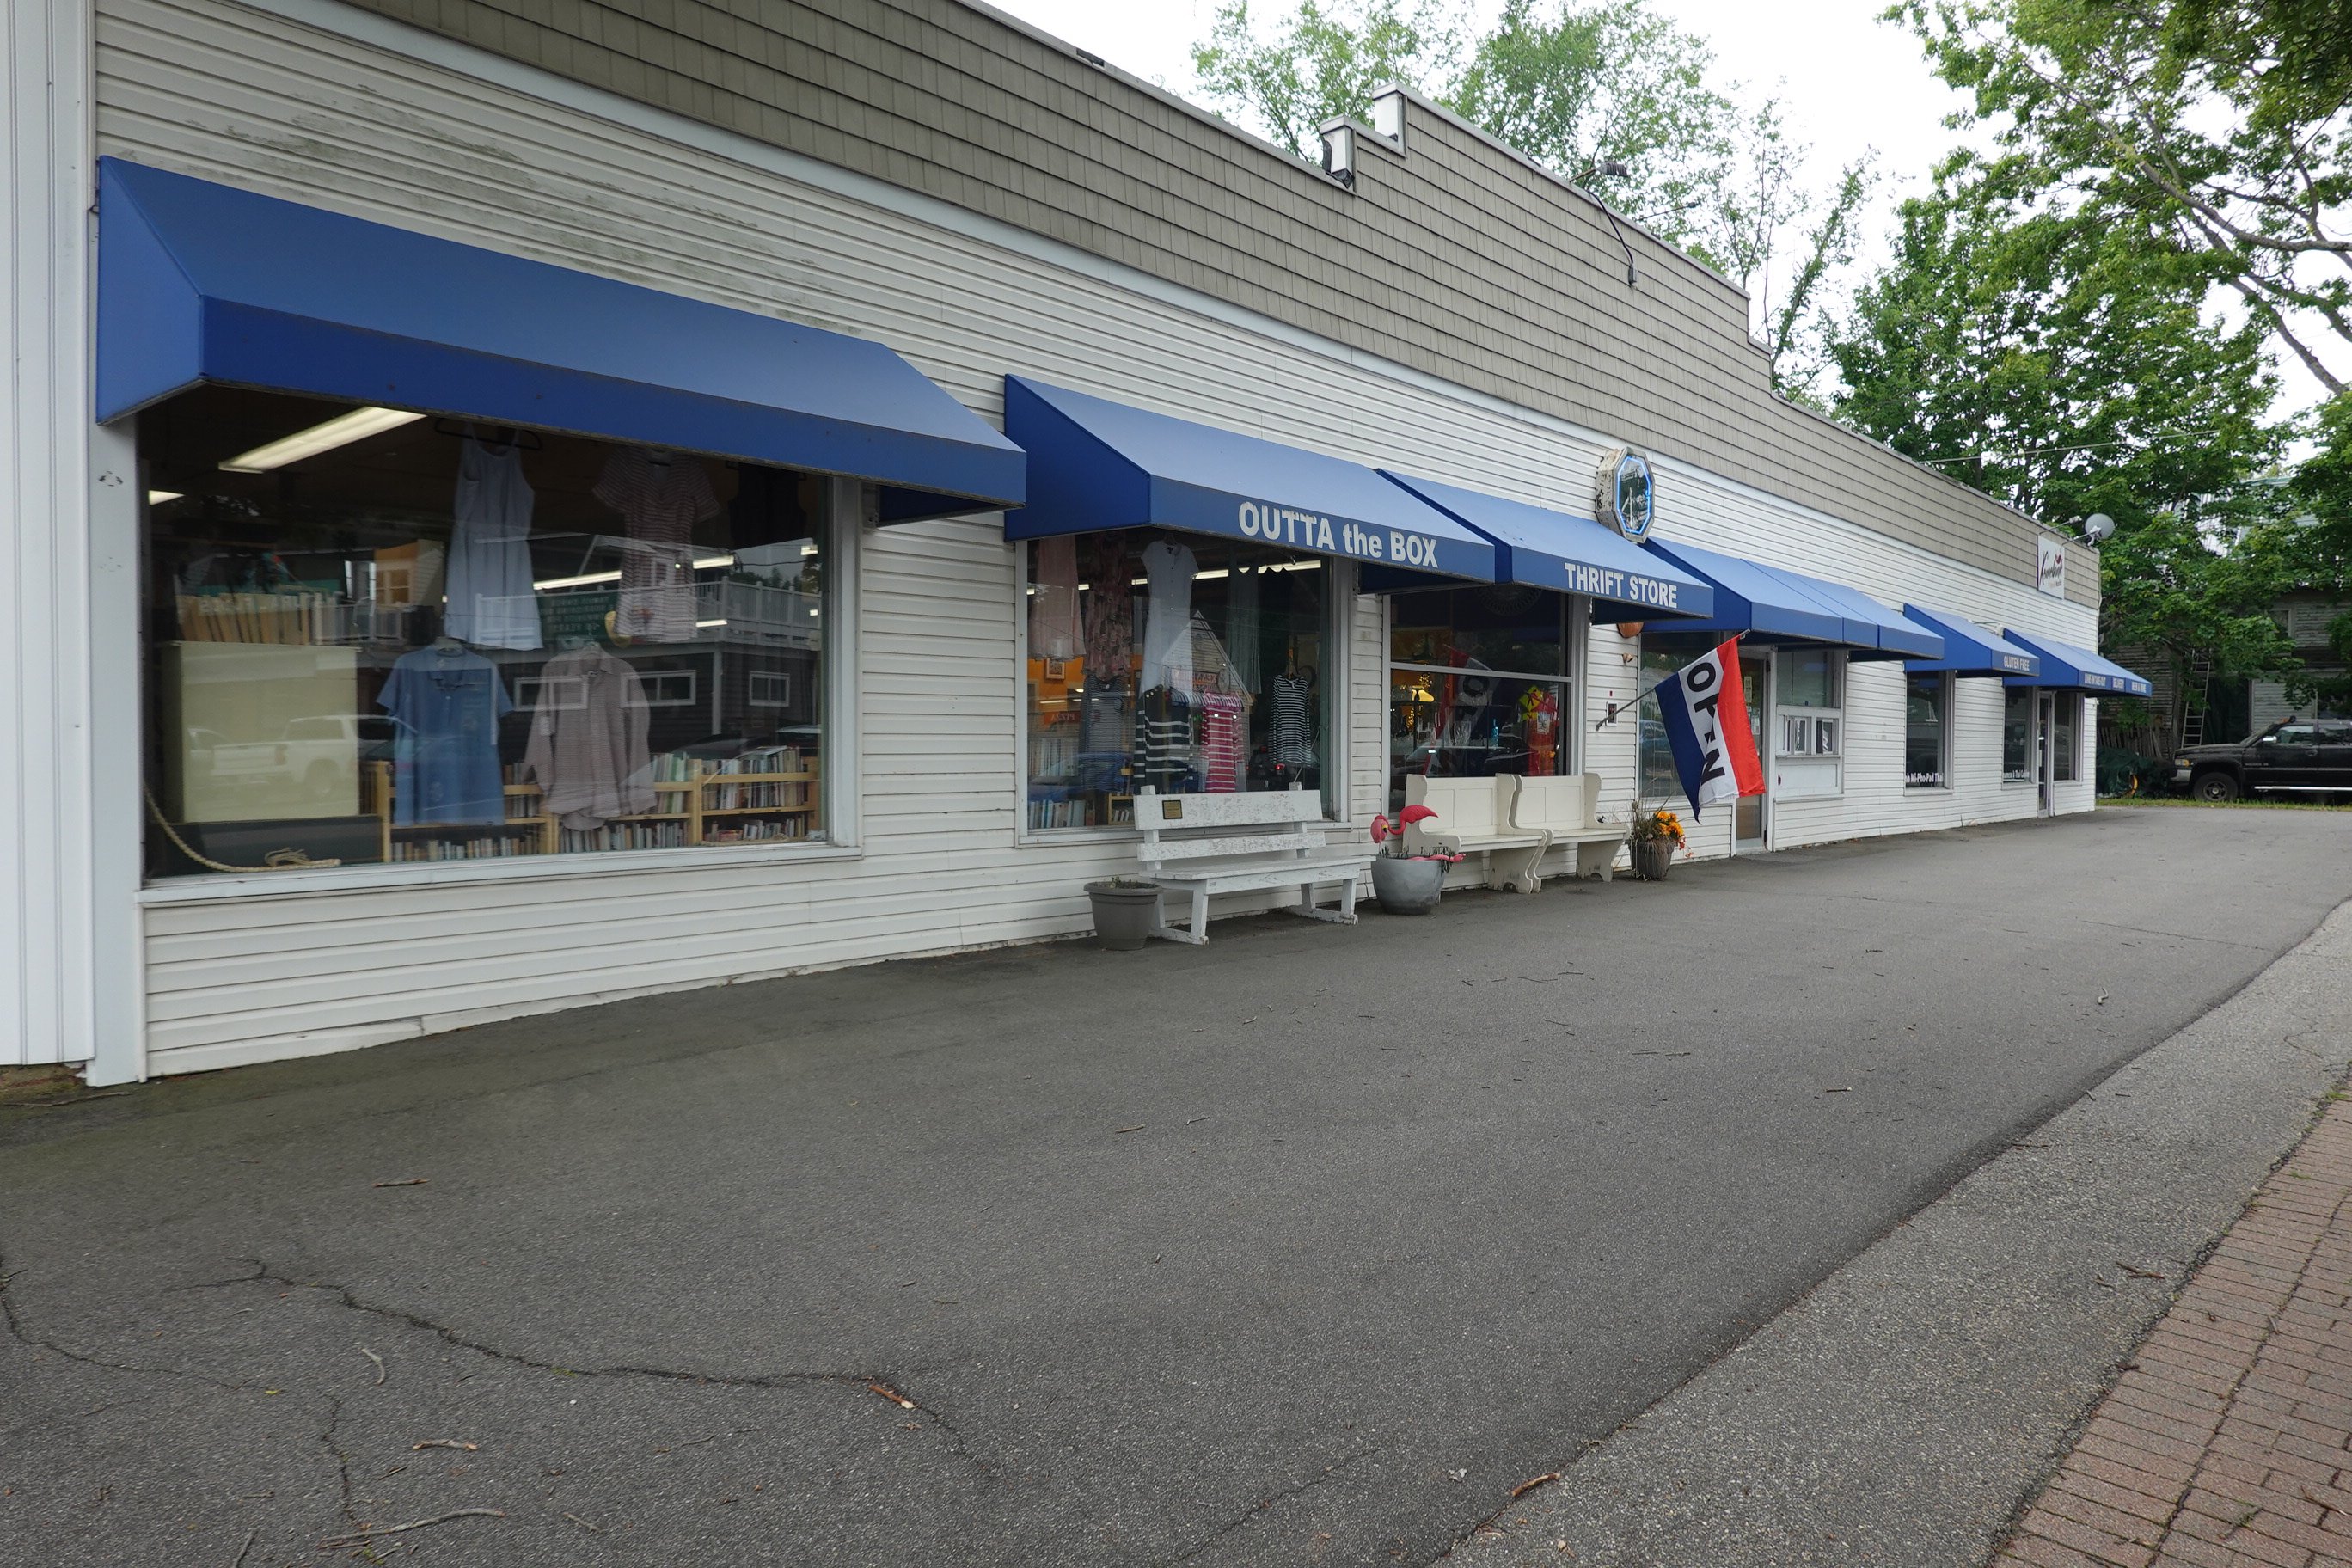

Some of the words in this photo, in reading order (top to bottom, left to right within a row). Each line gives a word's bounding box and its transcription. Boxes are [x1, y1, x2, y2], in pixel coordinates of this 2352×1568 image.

[1238, 501, 1336, 551] OUTTA
[1343, 523, 1383, 559] the
[1390, 530, 1439, 568] BOX
[1565, 562, 1624, 597] THRIFT
[1629, 575, 1677, 609] STORE
[2004, 655, 2019, 670] GLUTEN
[2019, 658, 2030, 672] FREE
